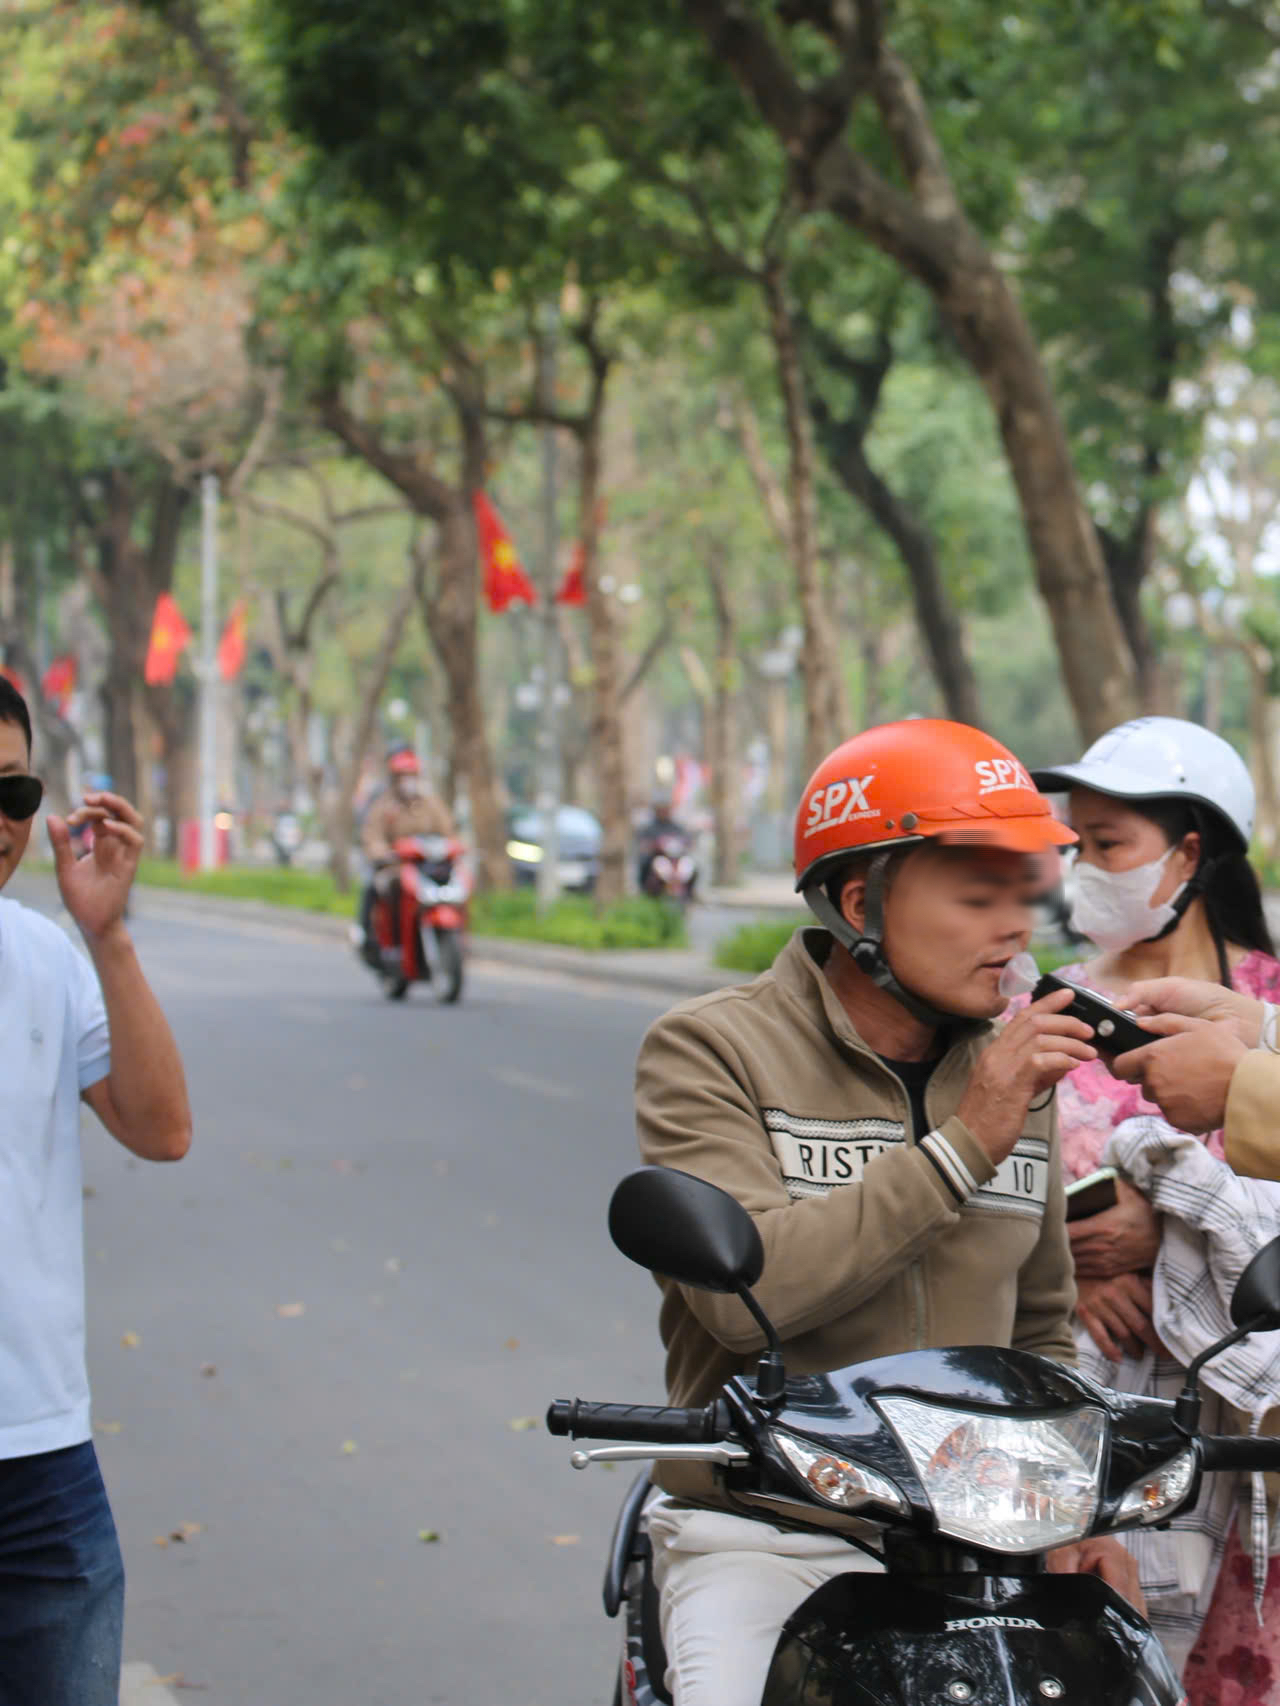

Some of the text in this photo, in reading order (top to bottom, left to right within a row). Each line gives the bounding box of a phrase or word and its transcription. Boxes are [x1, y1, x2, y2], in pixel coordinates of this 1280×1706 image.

[975, 759, 1030, 788] SPX
[805, 775, 875, 832] SPX
[798, 1143, 885, 1179] RIST
[944, 1616, 1045, 1632] HONDA
